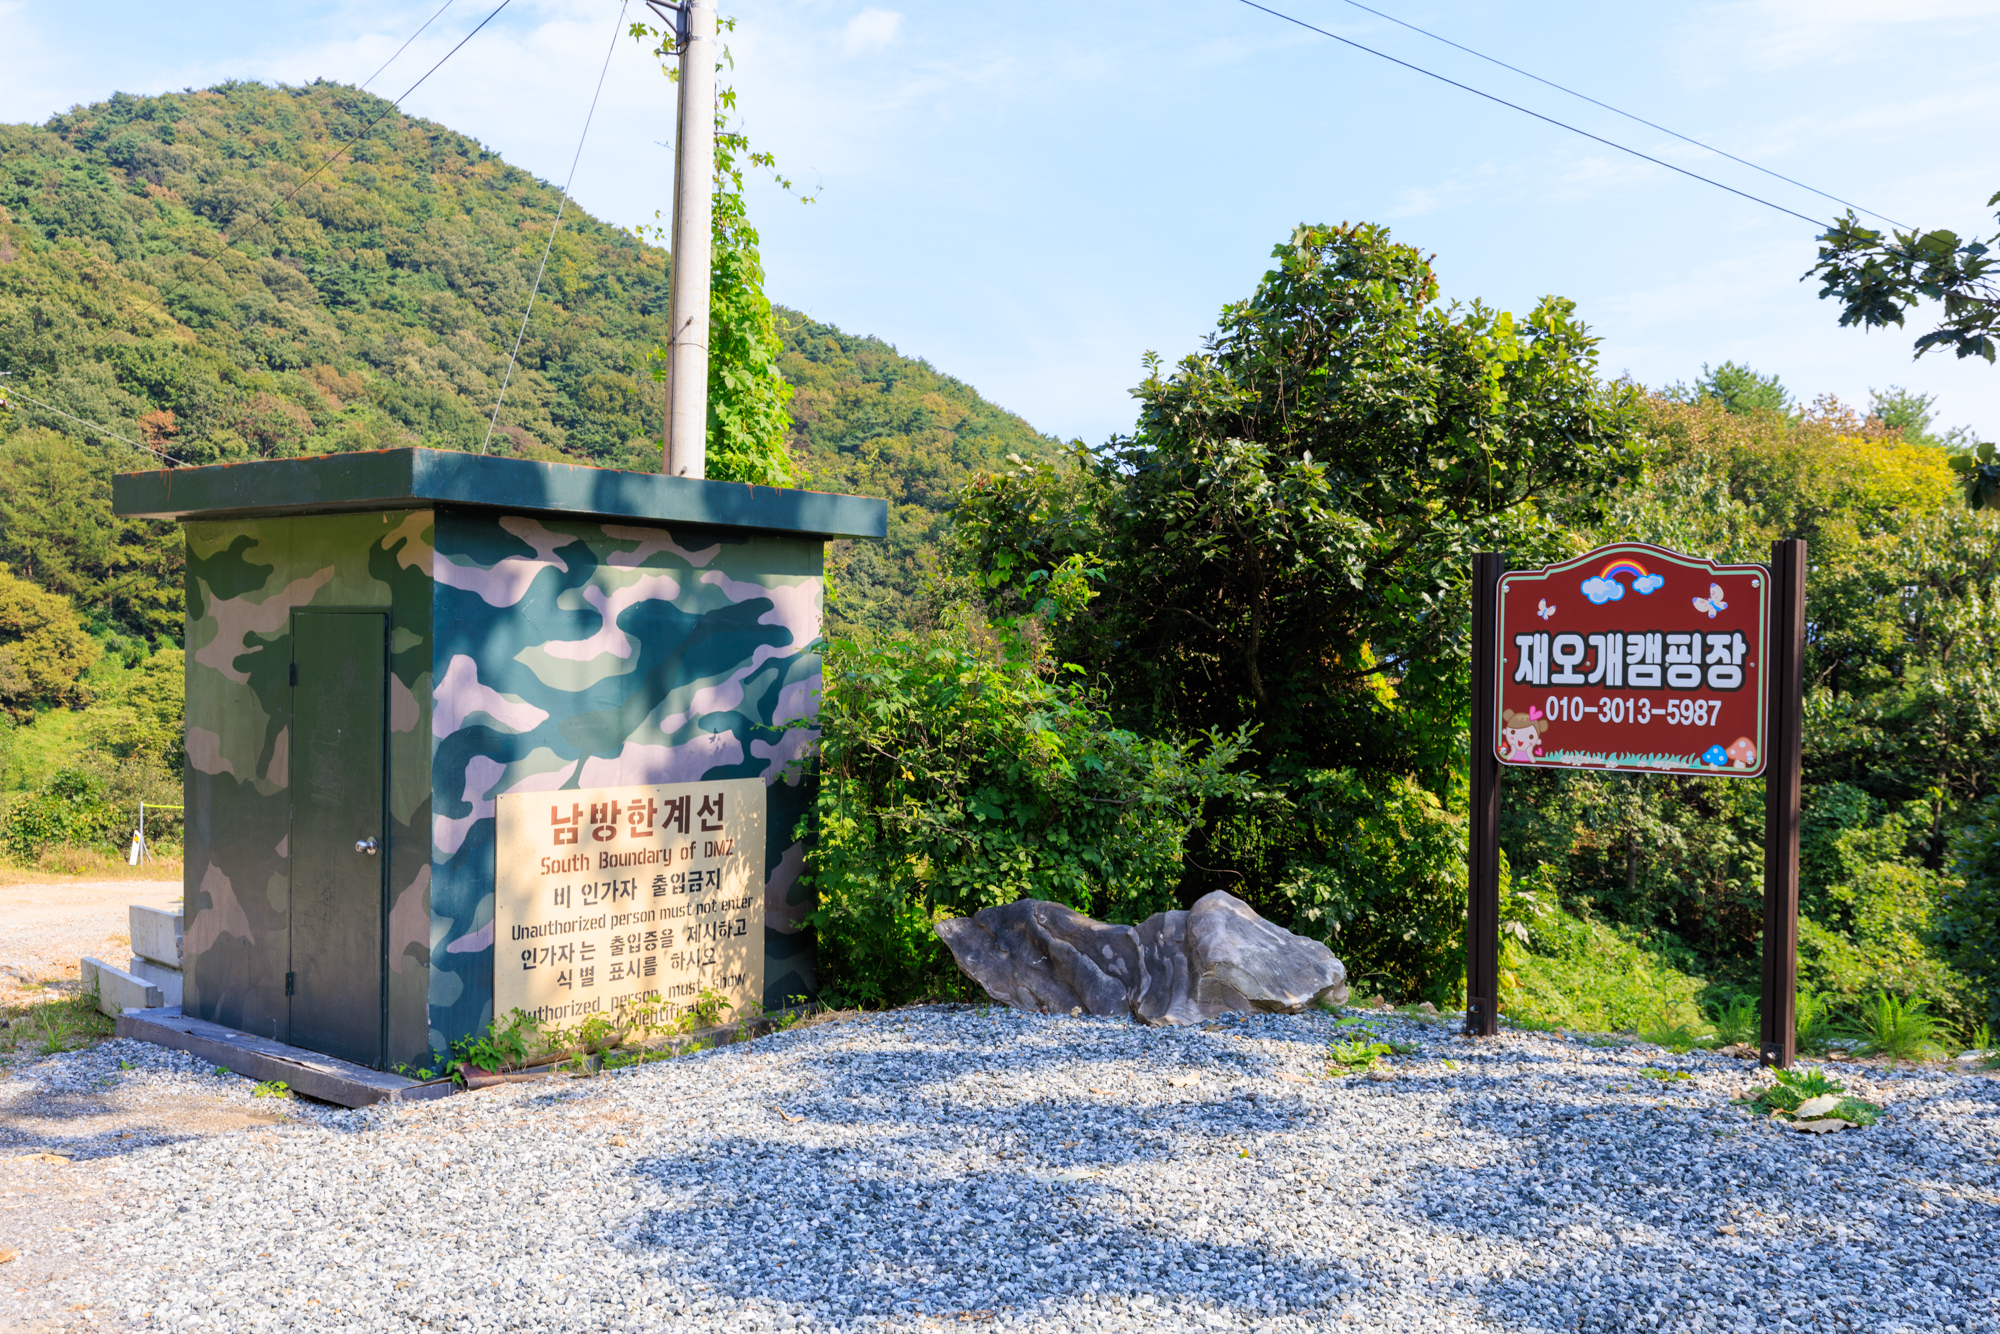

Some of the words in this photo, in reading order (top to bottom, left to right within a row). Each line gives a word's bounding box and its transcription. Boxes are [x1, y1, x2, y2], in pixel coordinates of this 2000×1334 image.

[1514, 632, 1748, 690] 재오개캠핑장
[1545, 696, 1722, 727] 010-3013-5987
[551, 792, 725, 846] 남방한계선
[541, 854, 590, 875] South
[599, 847, 672, 869] Boundary
[680, 841, 696, 861] of
[704, 839, 734, 859] DMZ
[581, 877, 638, 906] 인가자
[651, 868, 721, 897] 출입금지
[512, 913, 606, 941] Unauthorized
[611, 909, 656, 930] person
[659, 902, 692, 920] must
[696, 898, 718, 915] not
[721, 895, 754, 913] enter
[521, 941, 596, 970] 인가자는
[609, 928, 675, 957] 출입증을
[687, 918, 748, 944] 제시하고
[609, 956, 658, 982] 표시를
[670, 947, 716, 971] 하시오
[669, 979, 702, 998] must
[713, 973, 745, 990] show
